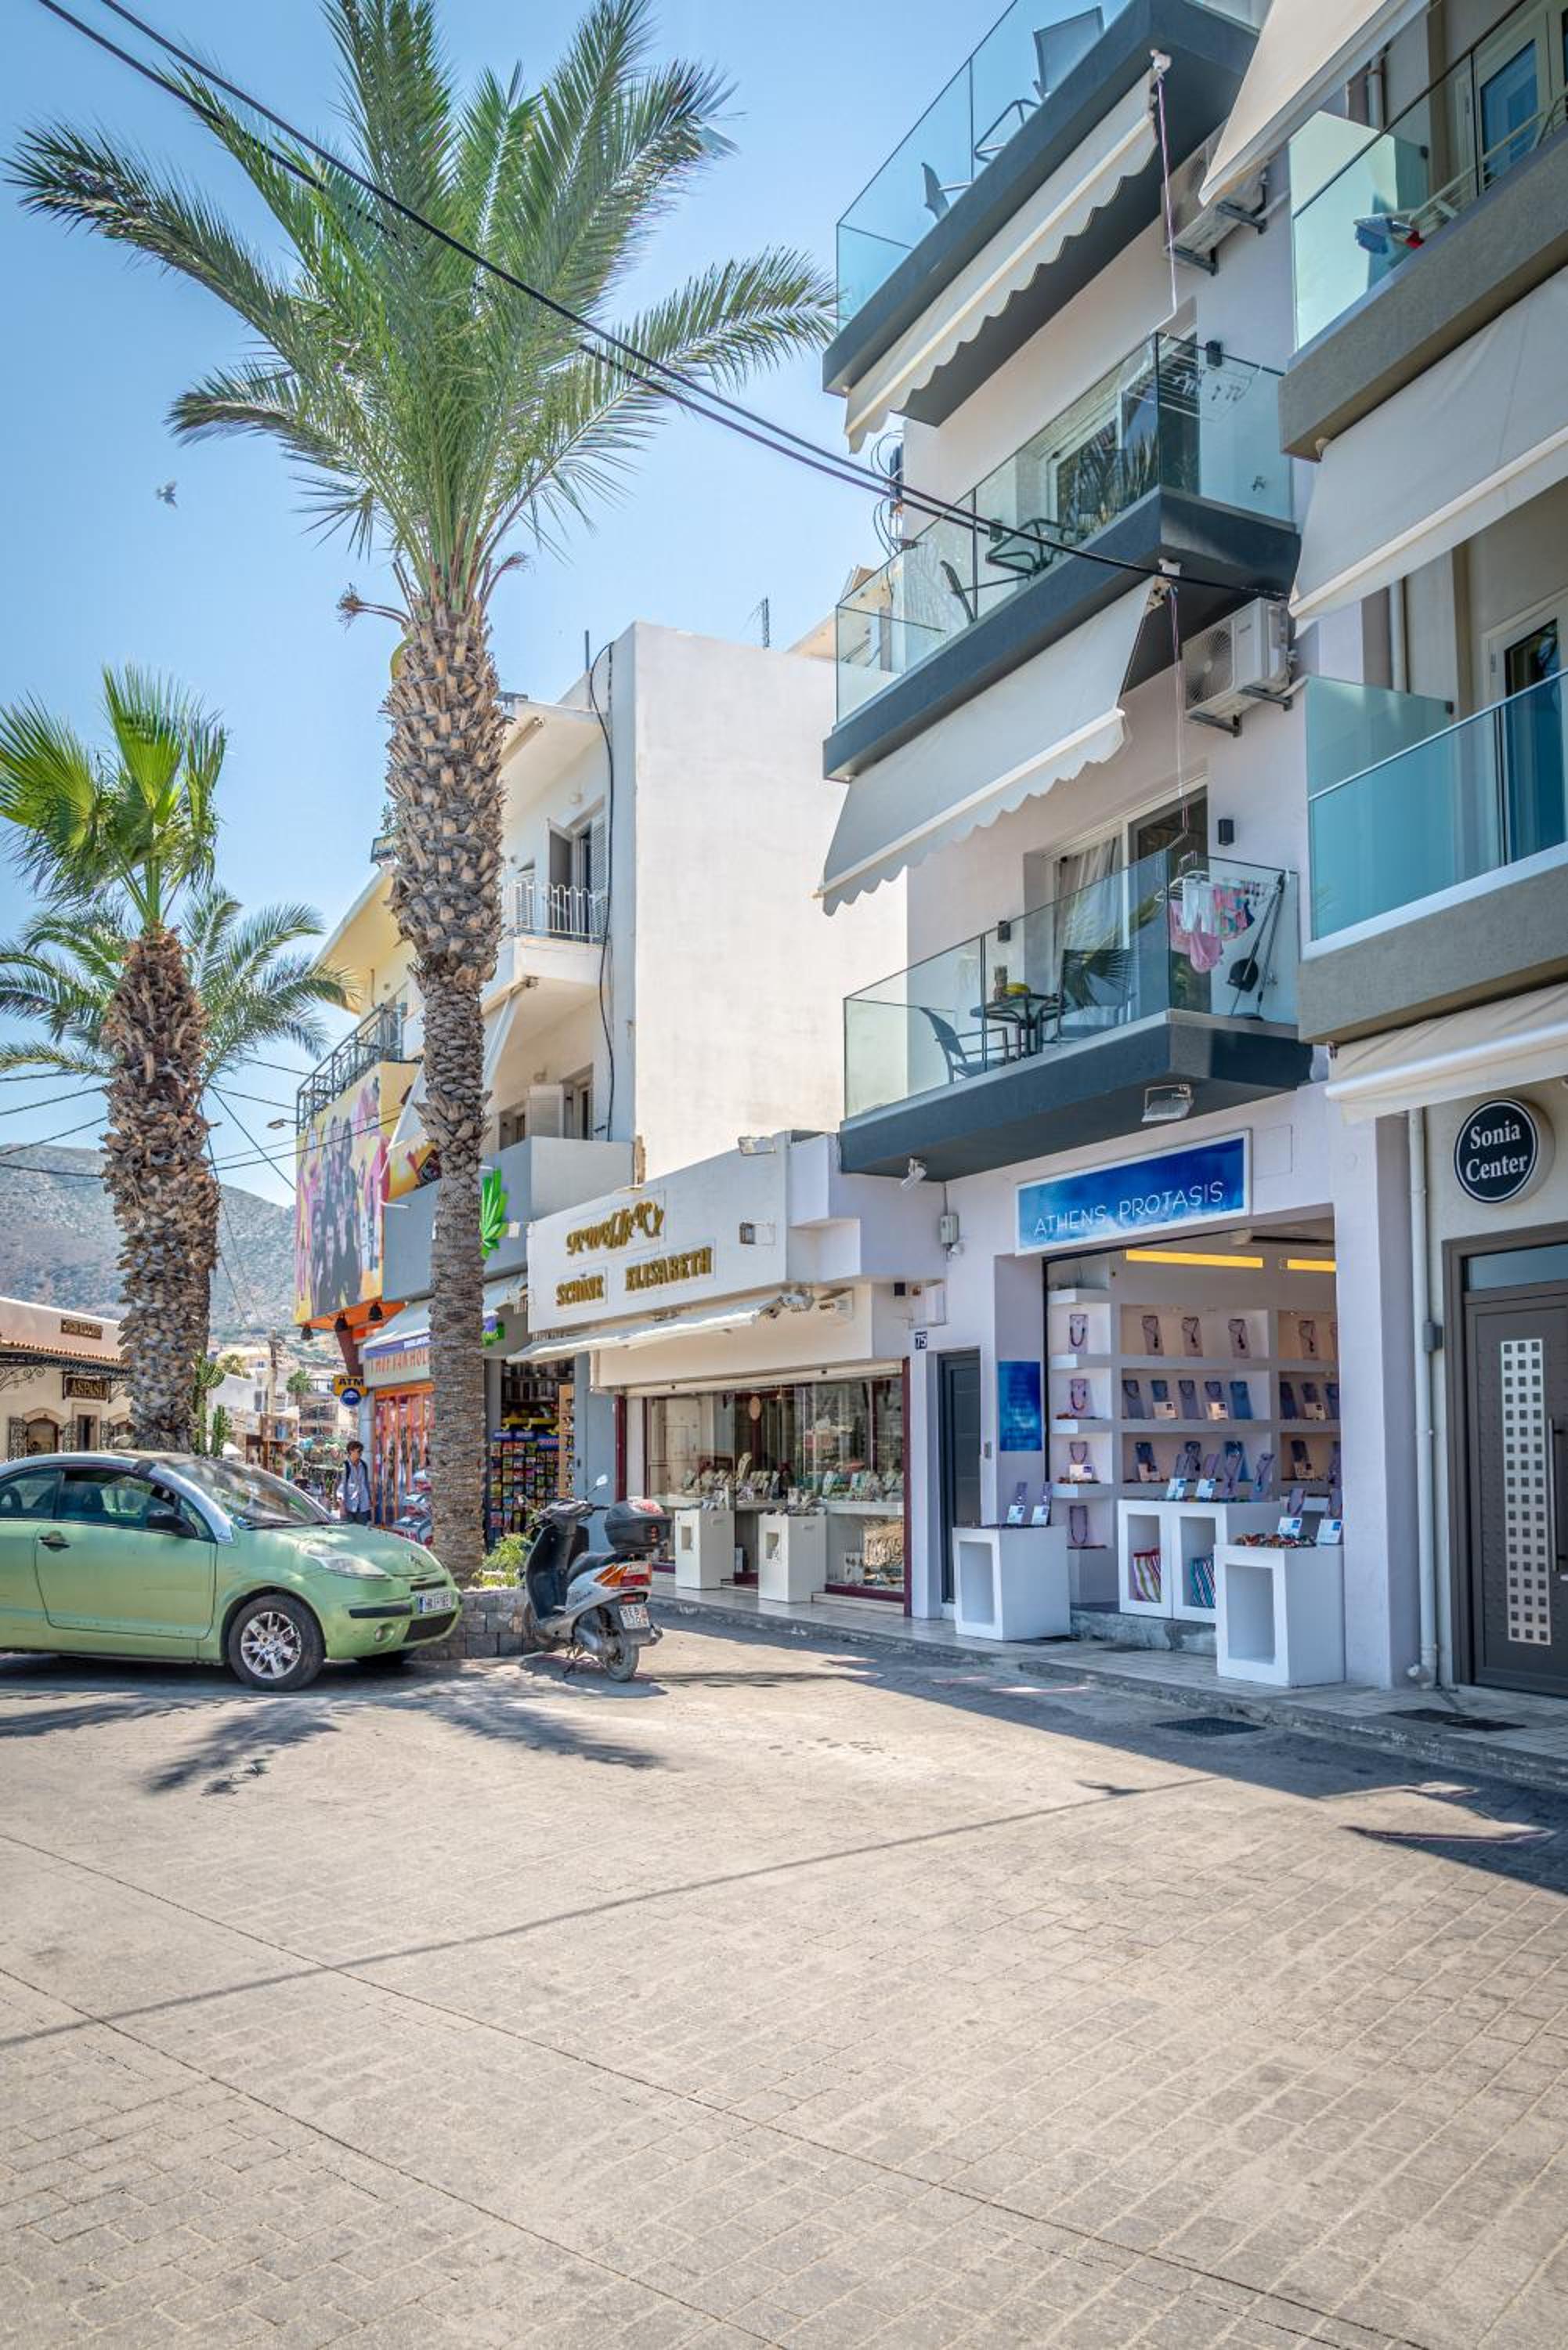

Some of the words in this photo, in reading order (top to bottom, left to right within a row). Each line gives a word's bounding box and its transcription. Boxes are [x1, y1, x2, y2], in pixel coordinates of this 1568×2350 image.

[1470, 1120, 1521, 1149] Sonia
[1465, 1155, 1528, 1182] Center
[1034, 1206, 1107, 1236] ATHENS
[1118, 1181, 1224, 1221] PROTASIS
[624, 1246, 712, 1292] ELISABETH
